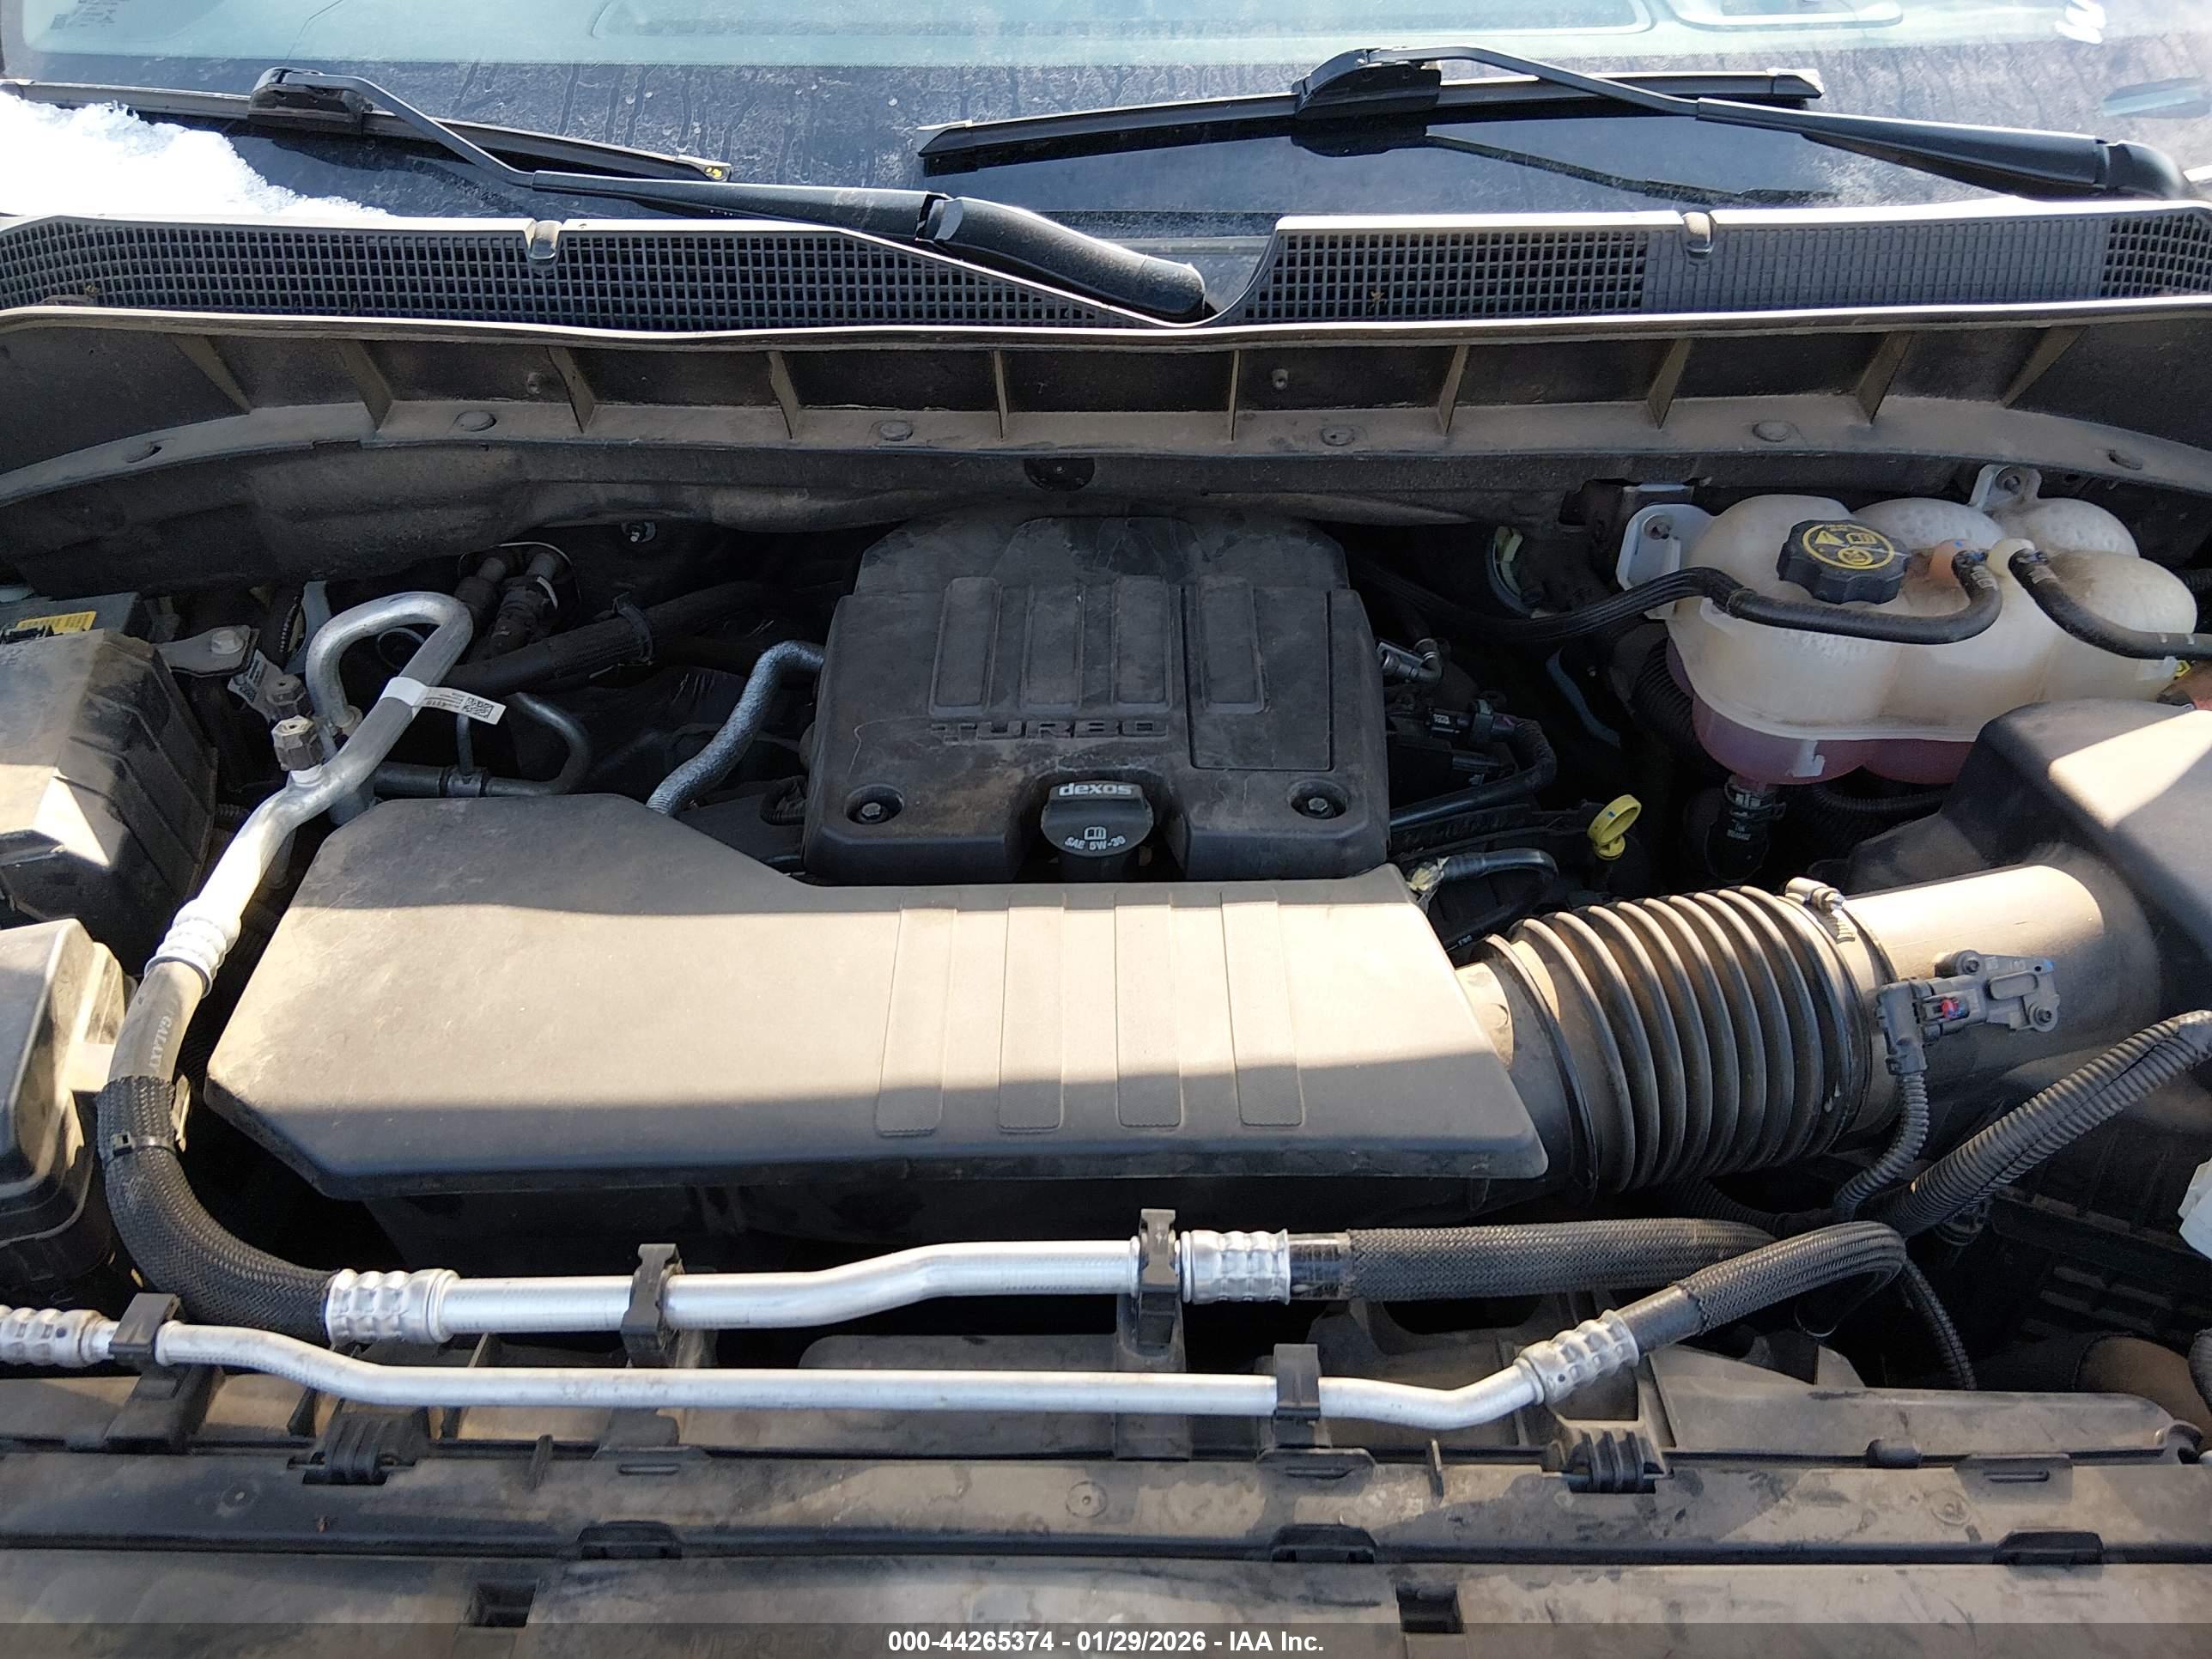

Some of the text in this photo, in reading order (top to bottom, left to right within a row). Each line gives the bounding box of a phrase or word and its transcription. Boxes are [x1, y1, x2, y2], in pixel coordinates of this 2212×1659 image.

[930, 720, 1169, 744] TURBO
[1059, 782, 1133, 796] dexos
[1064, 835, 1127, 851] SAE 5W-30
